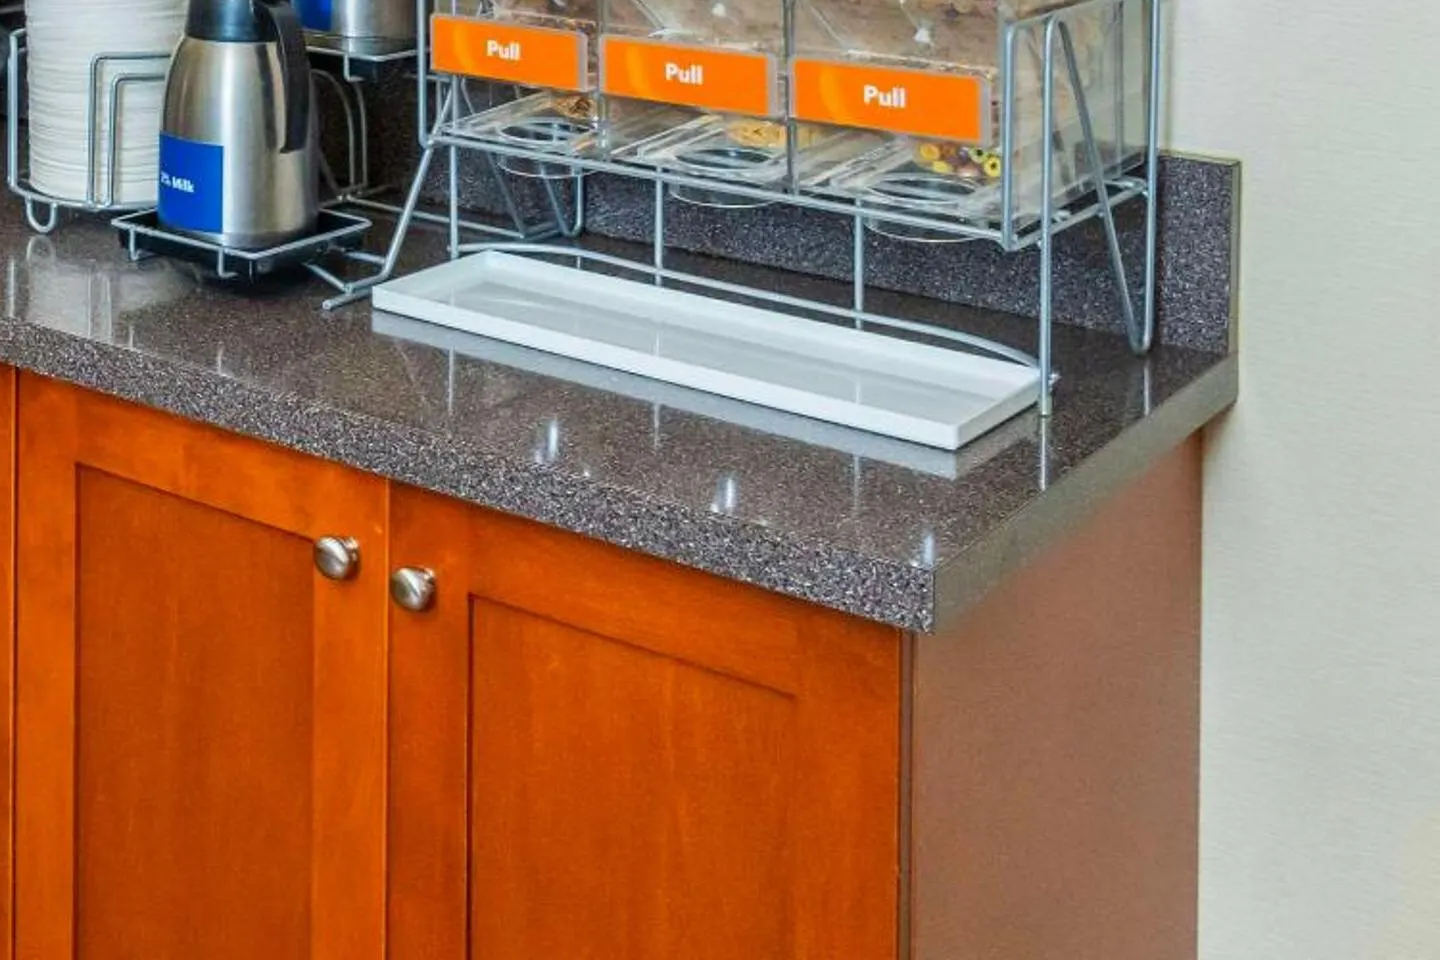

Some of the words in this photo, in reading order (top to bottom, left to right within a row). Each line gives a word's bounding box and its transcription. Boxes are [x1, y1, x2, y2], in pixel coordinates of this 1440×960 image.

[486, 38, 521, 62] Pull
[665, 62, 703, 86] Pull
[863, 84, 906, 110] Pull
[172, 176, 194, 193] Milk
